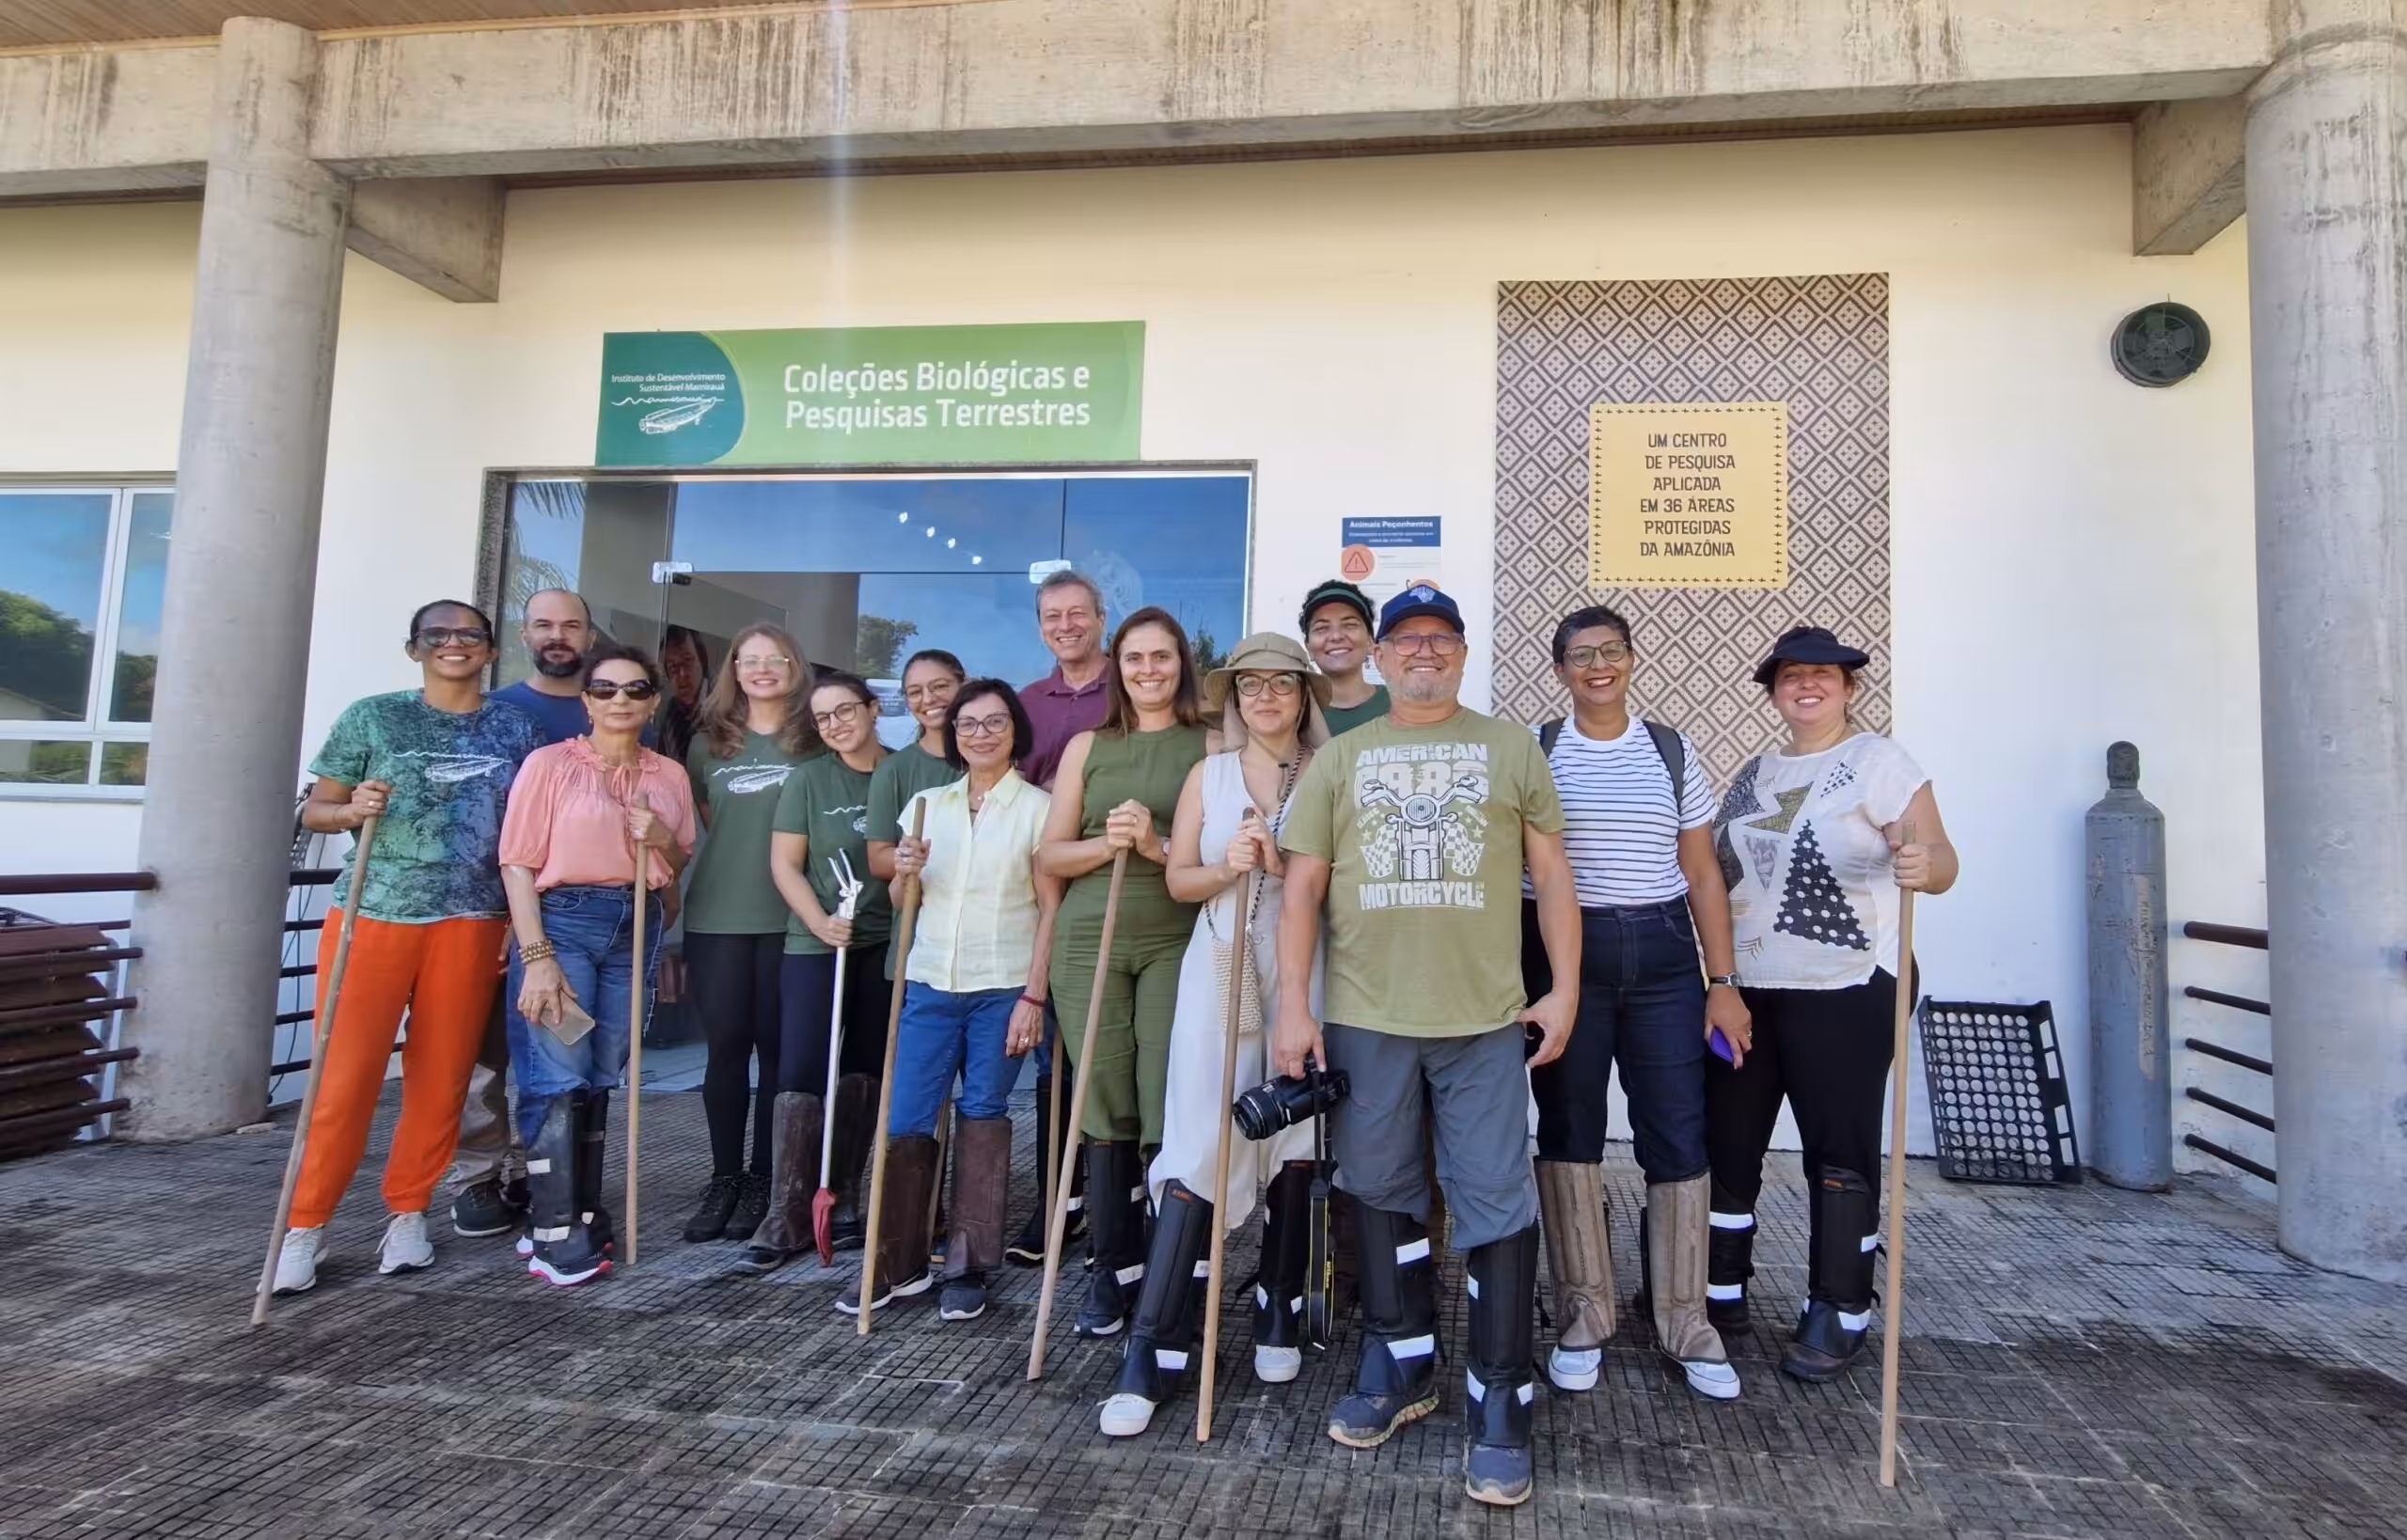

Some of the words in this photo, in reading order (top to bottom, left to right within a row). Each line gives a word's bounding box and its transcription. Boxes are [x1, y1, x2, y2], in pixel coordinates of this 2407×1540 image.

[611, 374, 644, 383] Instituto
[645, 373, 655, 383] de
[657, 372, 726, 383] Desenvolvimento
[784, 362, 908, 399] Coleções
[916, 359, 1065, 397] Biológicas
[1073, 366, 1090, 388] e
[639, 383, 684, 392] Sustentável
[685, 383, 725, 391] Mamirauá
[785, 399, 928, 435] Pesquisas
[936, 399, 1091, 427] Terrestres
[1647, 433, 1668, 448] UM
[1673, 432, 1727, 448] CENTRO
[1644, 455, 1662, 469] DE
[1668, 454, 1736, 472] PESQUISA
[1653, 477, 1722, 491] APLICADA
[1640, 498, 1658, 512] EM
[1663, 498, 1682, 512] 36
[1688, 495, 1735, 512] ÁREAS
[1644, 520, 1731, 535] PROTEGIDAS
[1640, 542, 1659, 557] DA
[1663, 539, 1736, 557] AMAZÔNIA
[1355, 743, 1488, 769] AMERICAN
[1359, 881, 1486, 910] MOTORCYCLE
